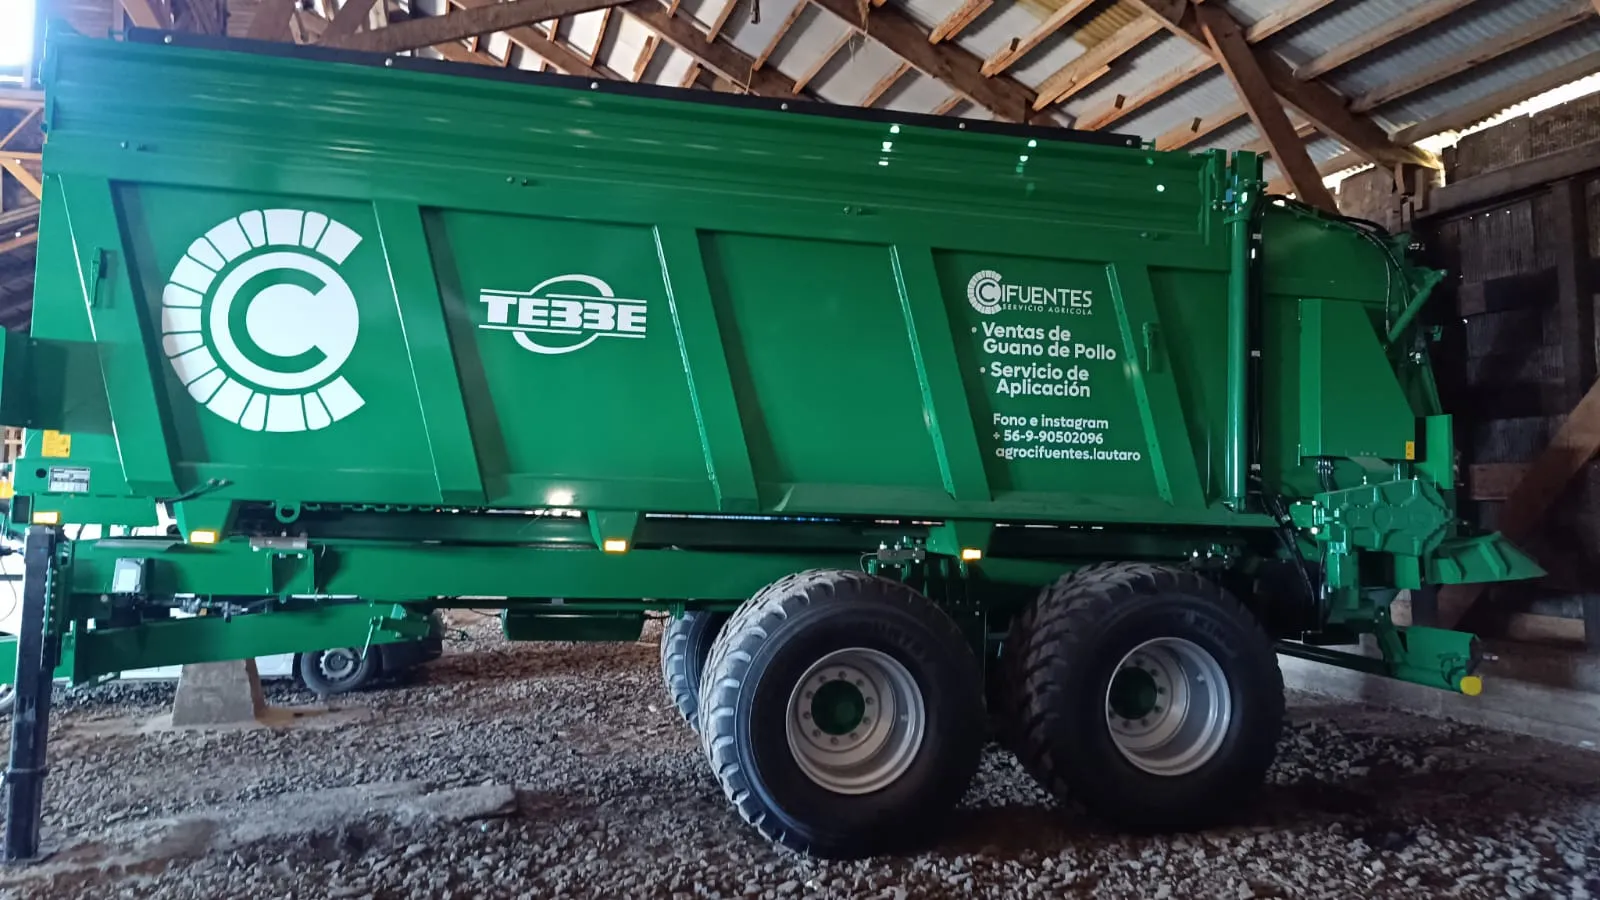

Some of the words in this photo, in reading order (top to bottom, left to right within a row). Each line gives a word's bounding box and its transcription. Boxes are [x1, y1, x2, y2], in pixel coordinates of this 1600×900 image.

[480, 294, 647, 333] TEBBE
[1002, 303, 1044, 313] SERVICIO
[1048, 306, 1093, 316] AGRICOLA
[982, 321, 1045, 340] Ventas
[1048, 325, 1072, 342] de
[983, 338, 1044, 356] Guano
[1047, 341, 1070, 358] de
[1074, 343, 1117, 361] Pollo
[990, 361, 1063, 380] Servicio
[1066, 365, 1090, 381] de
[996, 378, 1091, 398] Aplicación
[993, 412, 1027, 427] Fono
[1029, 416, 1039, 427] e
[1041, 414, 1109, 430] instagram
[1003, 429, 1104, 445] 56-9-90502096
[995, 445, 1142, 462] agrocifuentes.lautaro
